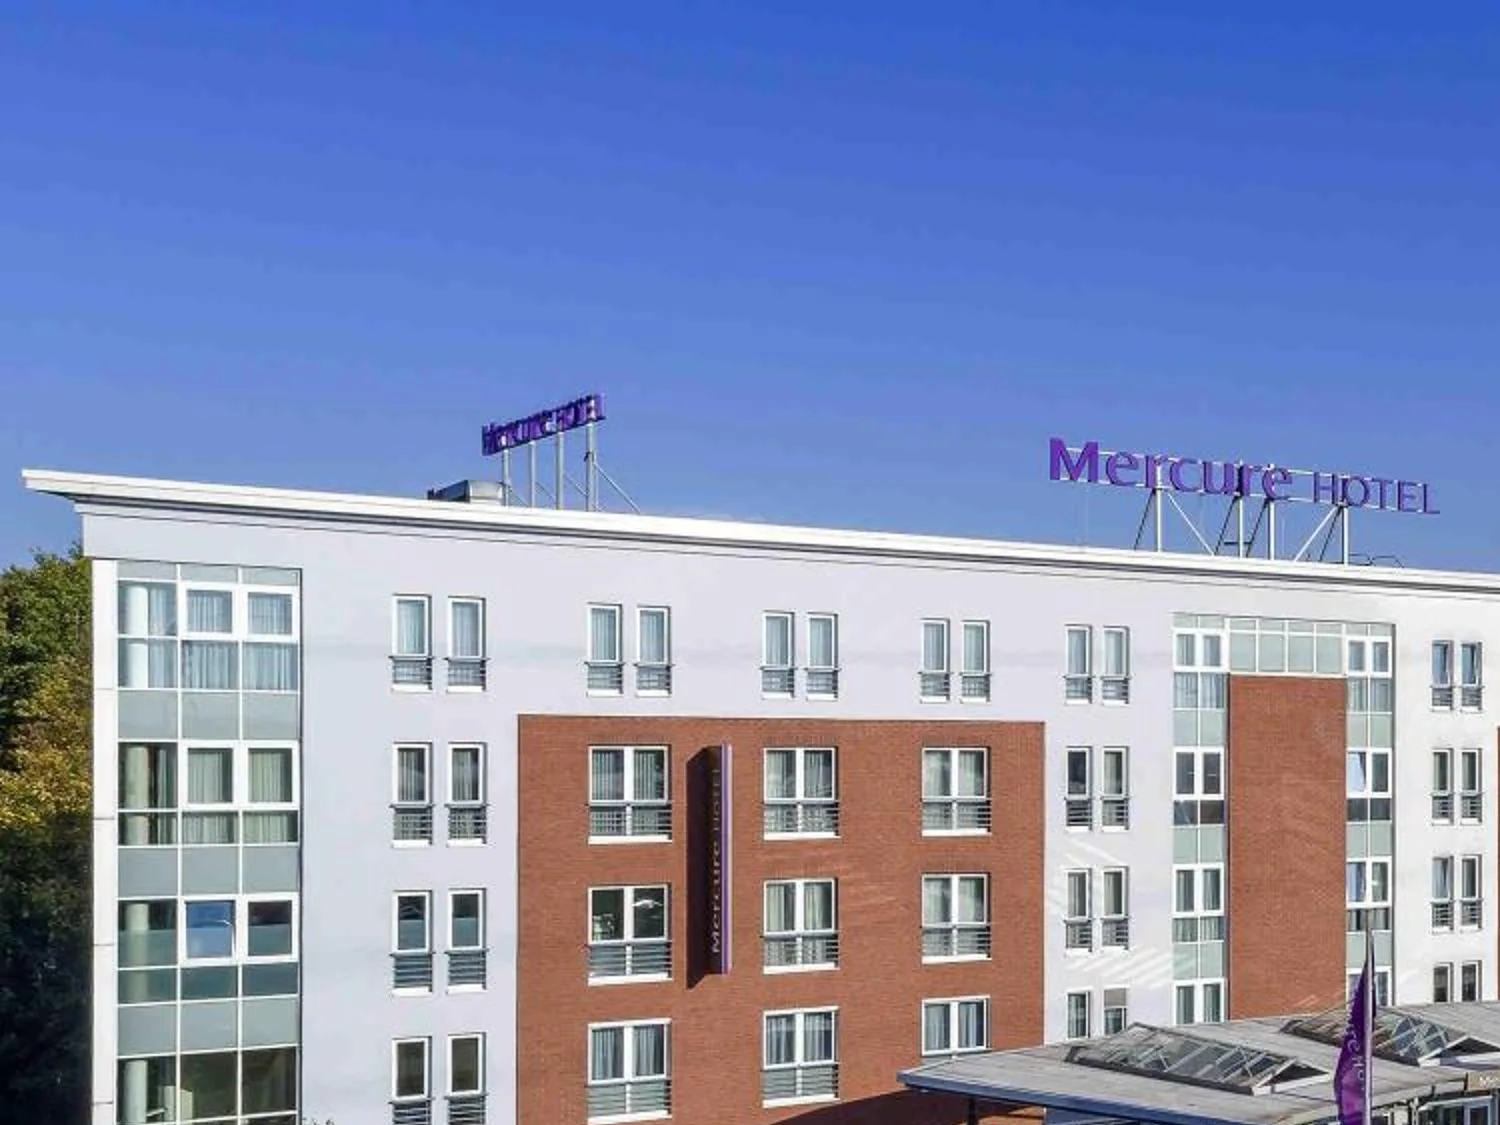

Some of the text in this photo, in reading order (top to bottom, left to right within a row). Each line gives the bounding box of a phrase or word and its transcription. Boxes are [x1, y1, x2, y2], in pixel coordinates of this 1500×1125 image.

[1049, 437, 1440, 515] Mercure HOTEL
[712, 841, 721, 953] Mercure
